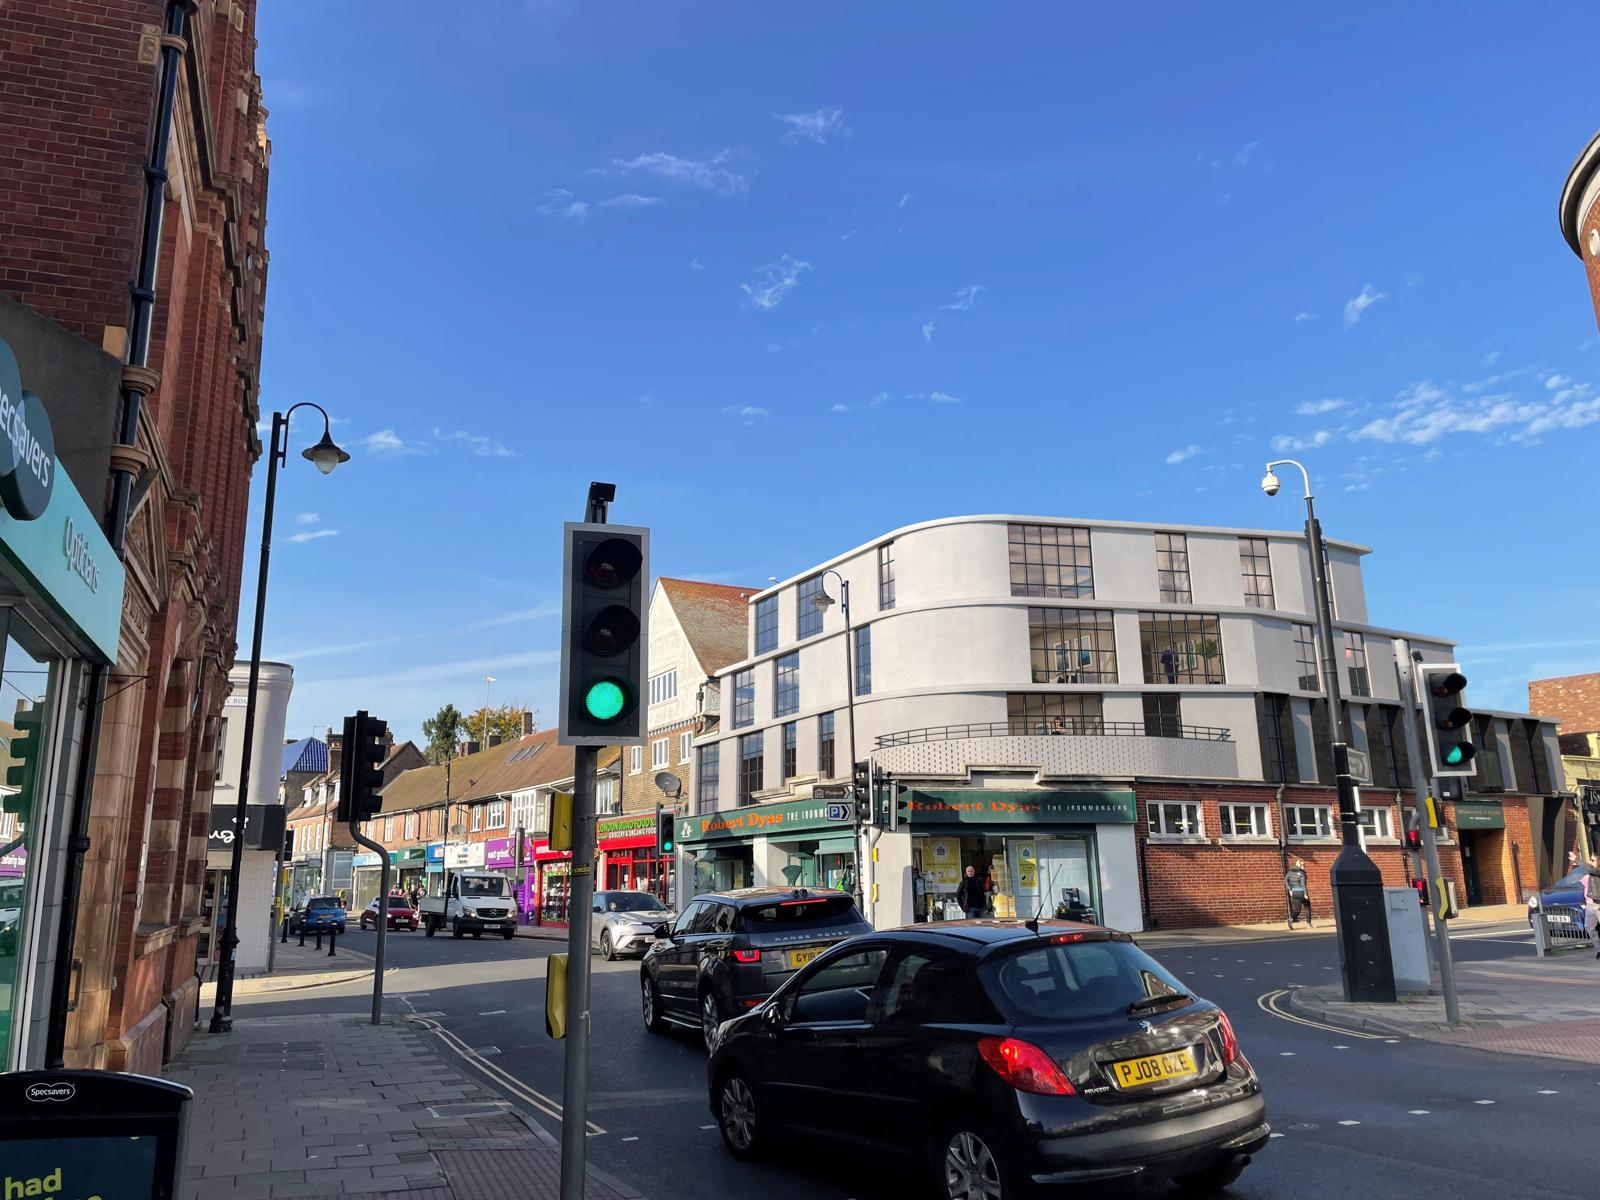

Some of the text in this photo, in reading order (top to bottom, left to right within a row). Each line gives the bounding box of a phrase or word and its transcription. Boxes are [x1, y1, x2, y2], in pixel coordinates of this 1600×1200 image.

[0, 387, 51, 489] ecsavers
[64, 515, 100, 596] Opticians
[831, 808, 839, 817] P
[908, 801, 982, 812] Robert
[990, 801, 1041, 813] Dyas
[1067, 804, 1128, 812] IRONMONGERS
[598, 822, 618, 833] LONDON
[618, 819, 634, 830] ROAD
[635, 817, 649, 828] FOOD
[701, 817, 745, 832] Robert
[748, 812, 784, 829] Dyas
[787, 812, 798, 821] THE
[1120, 1058, 1162, 1082] PJ08
[31, 1088, 70, 1097] Specsavers
[5, 1167, 62, 1200] had
